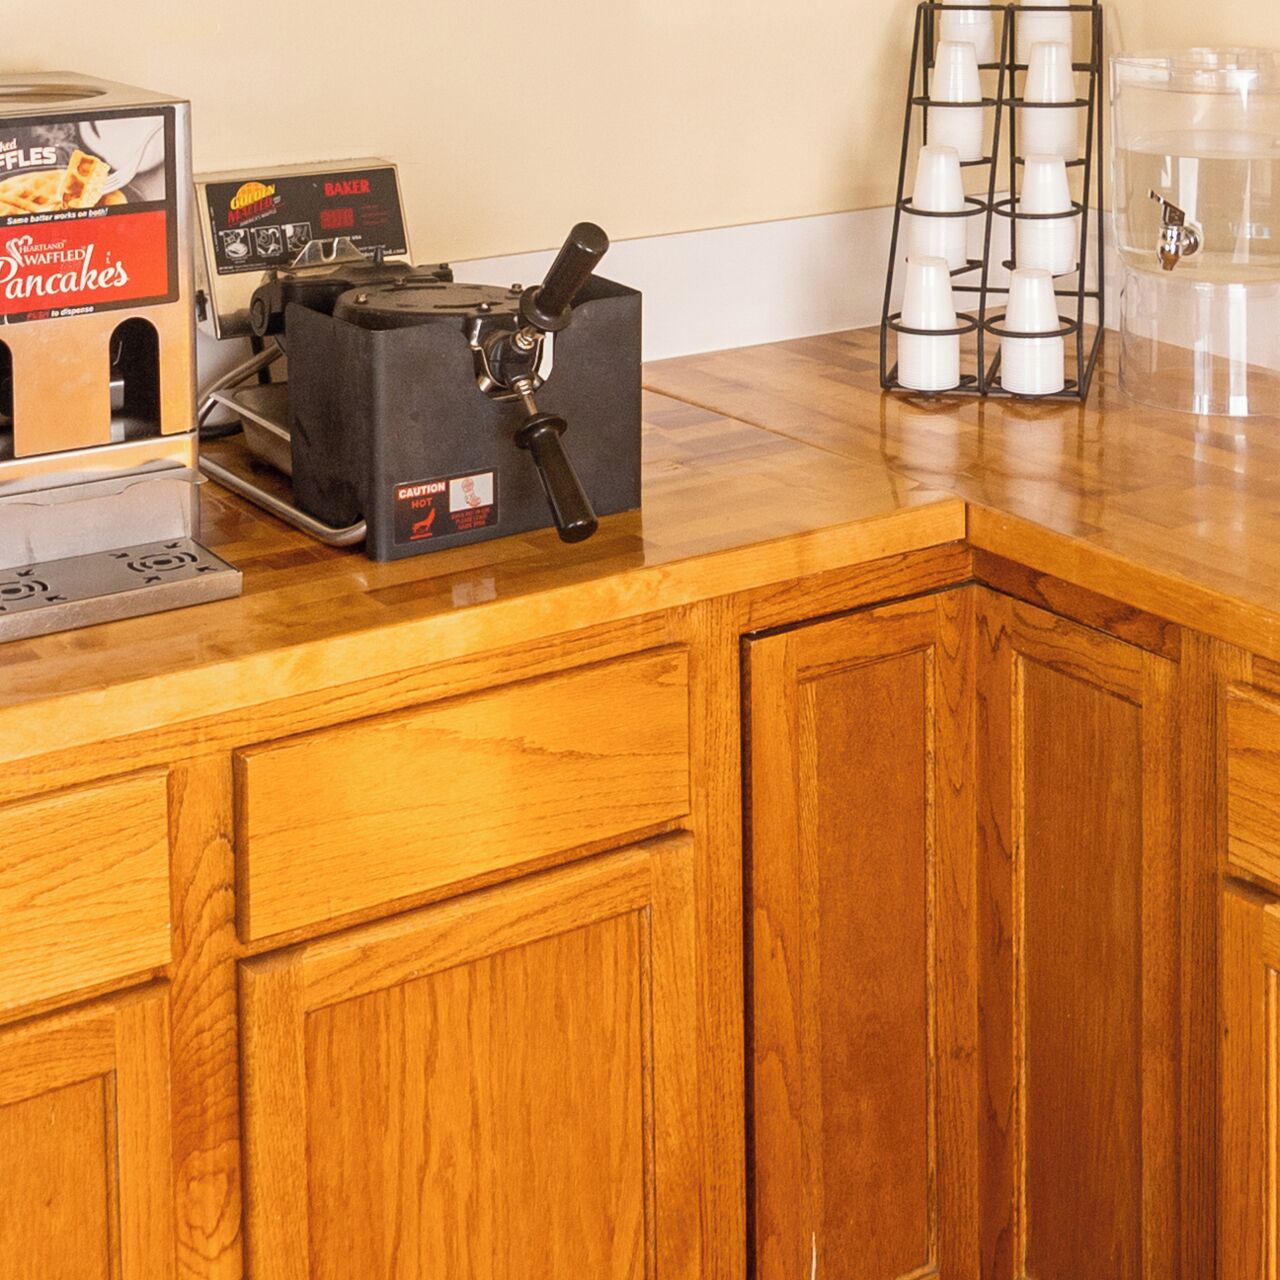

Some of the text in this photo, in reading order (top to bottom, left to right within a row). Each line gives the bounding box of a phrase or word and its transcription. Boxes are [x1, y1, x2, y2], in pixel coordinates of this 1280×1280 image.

[324, 179, 370, 196] BAKER
[7, 216, 29, 226] Same
[54, 211, 76, 220] works
[77, 210, 87, 218] on
[24, 247, 86, 266] WAFFLED
[51, 309, 60, 318] to
[60, 306, 95, 316] dispense
[398, 482, 446, 499] CAUTION
[411, 497, 433, 509] HOT
